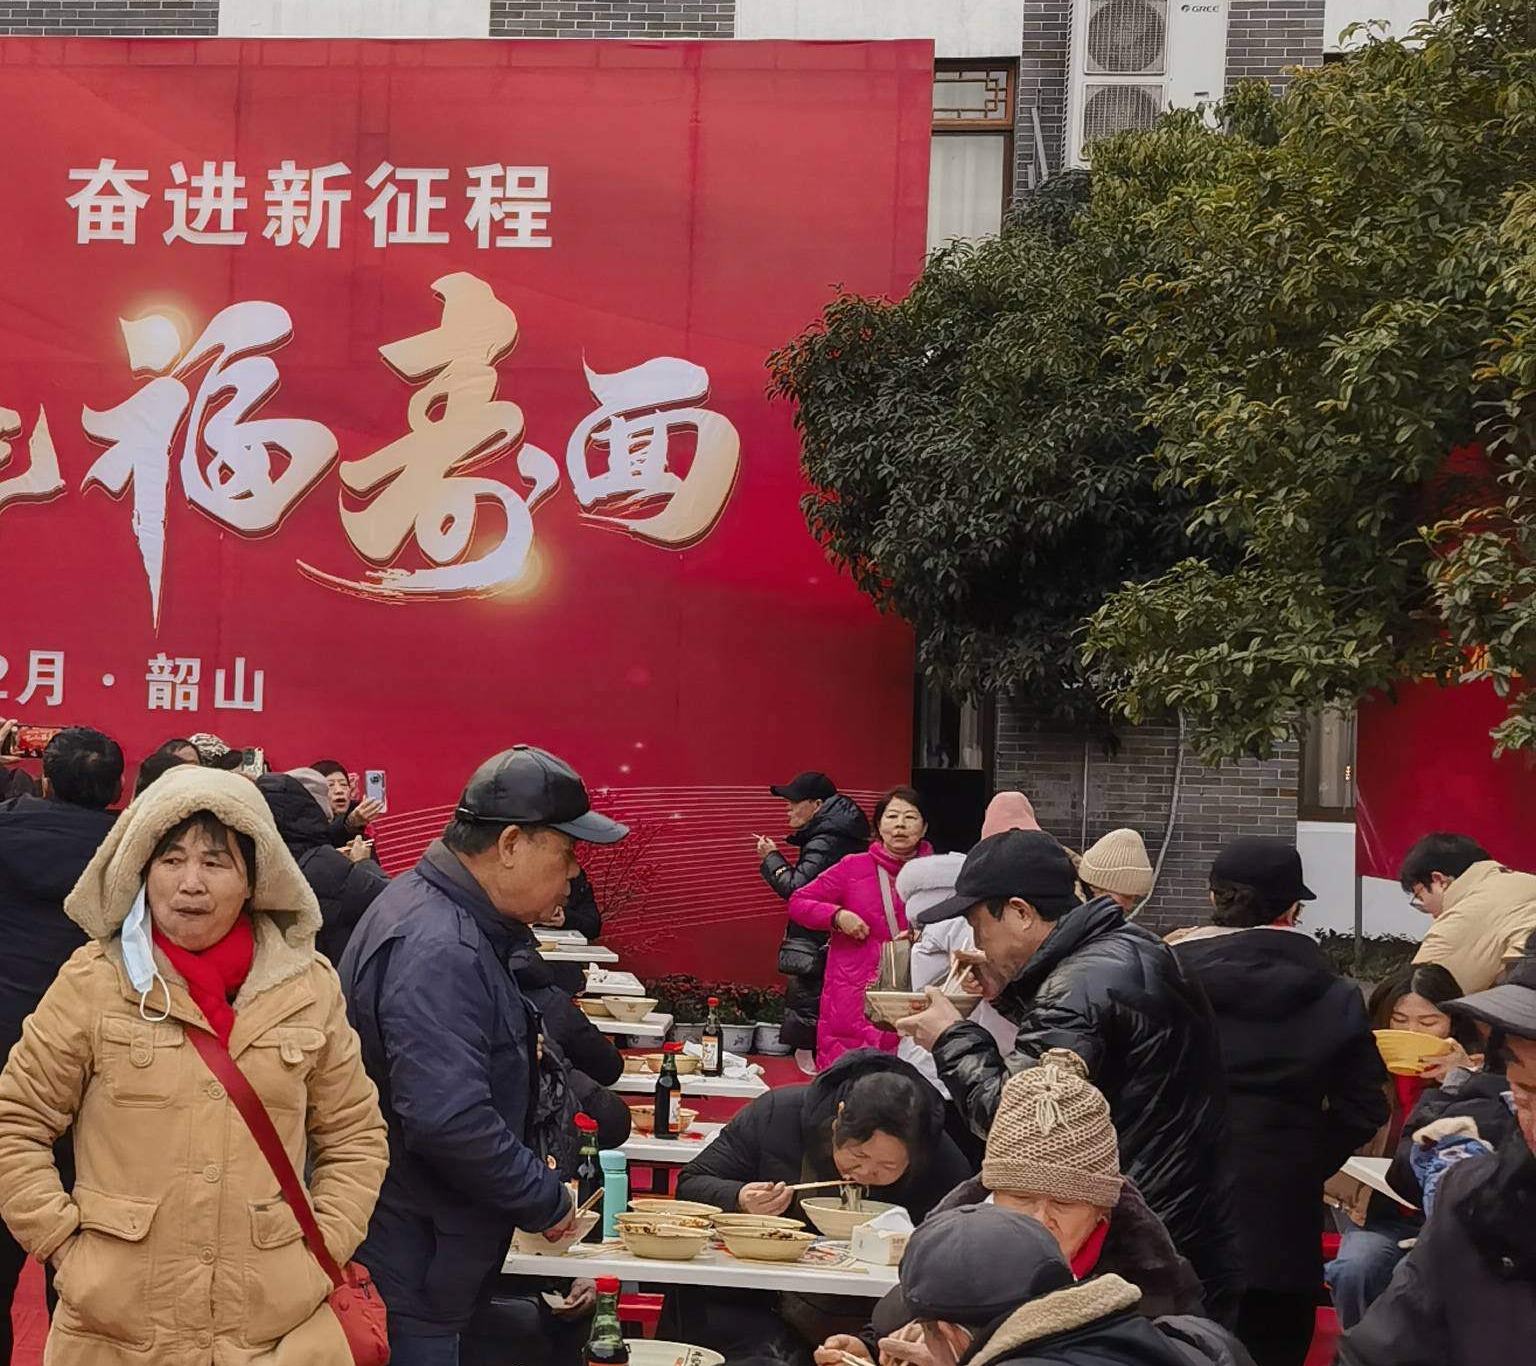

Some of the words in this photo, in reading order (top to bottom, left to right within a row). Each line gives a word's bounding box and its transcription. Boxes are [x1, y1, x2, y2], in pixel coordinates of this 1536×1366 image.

[65, 157, 554, 249] 奋进新征程
